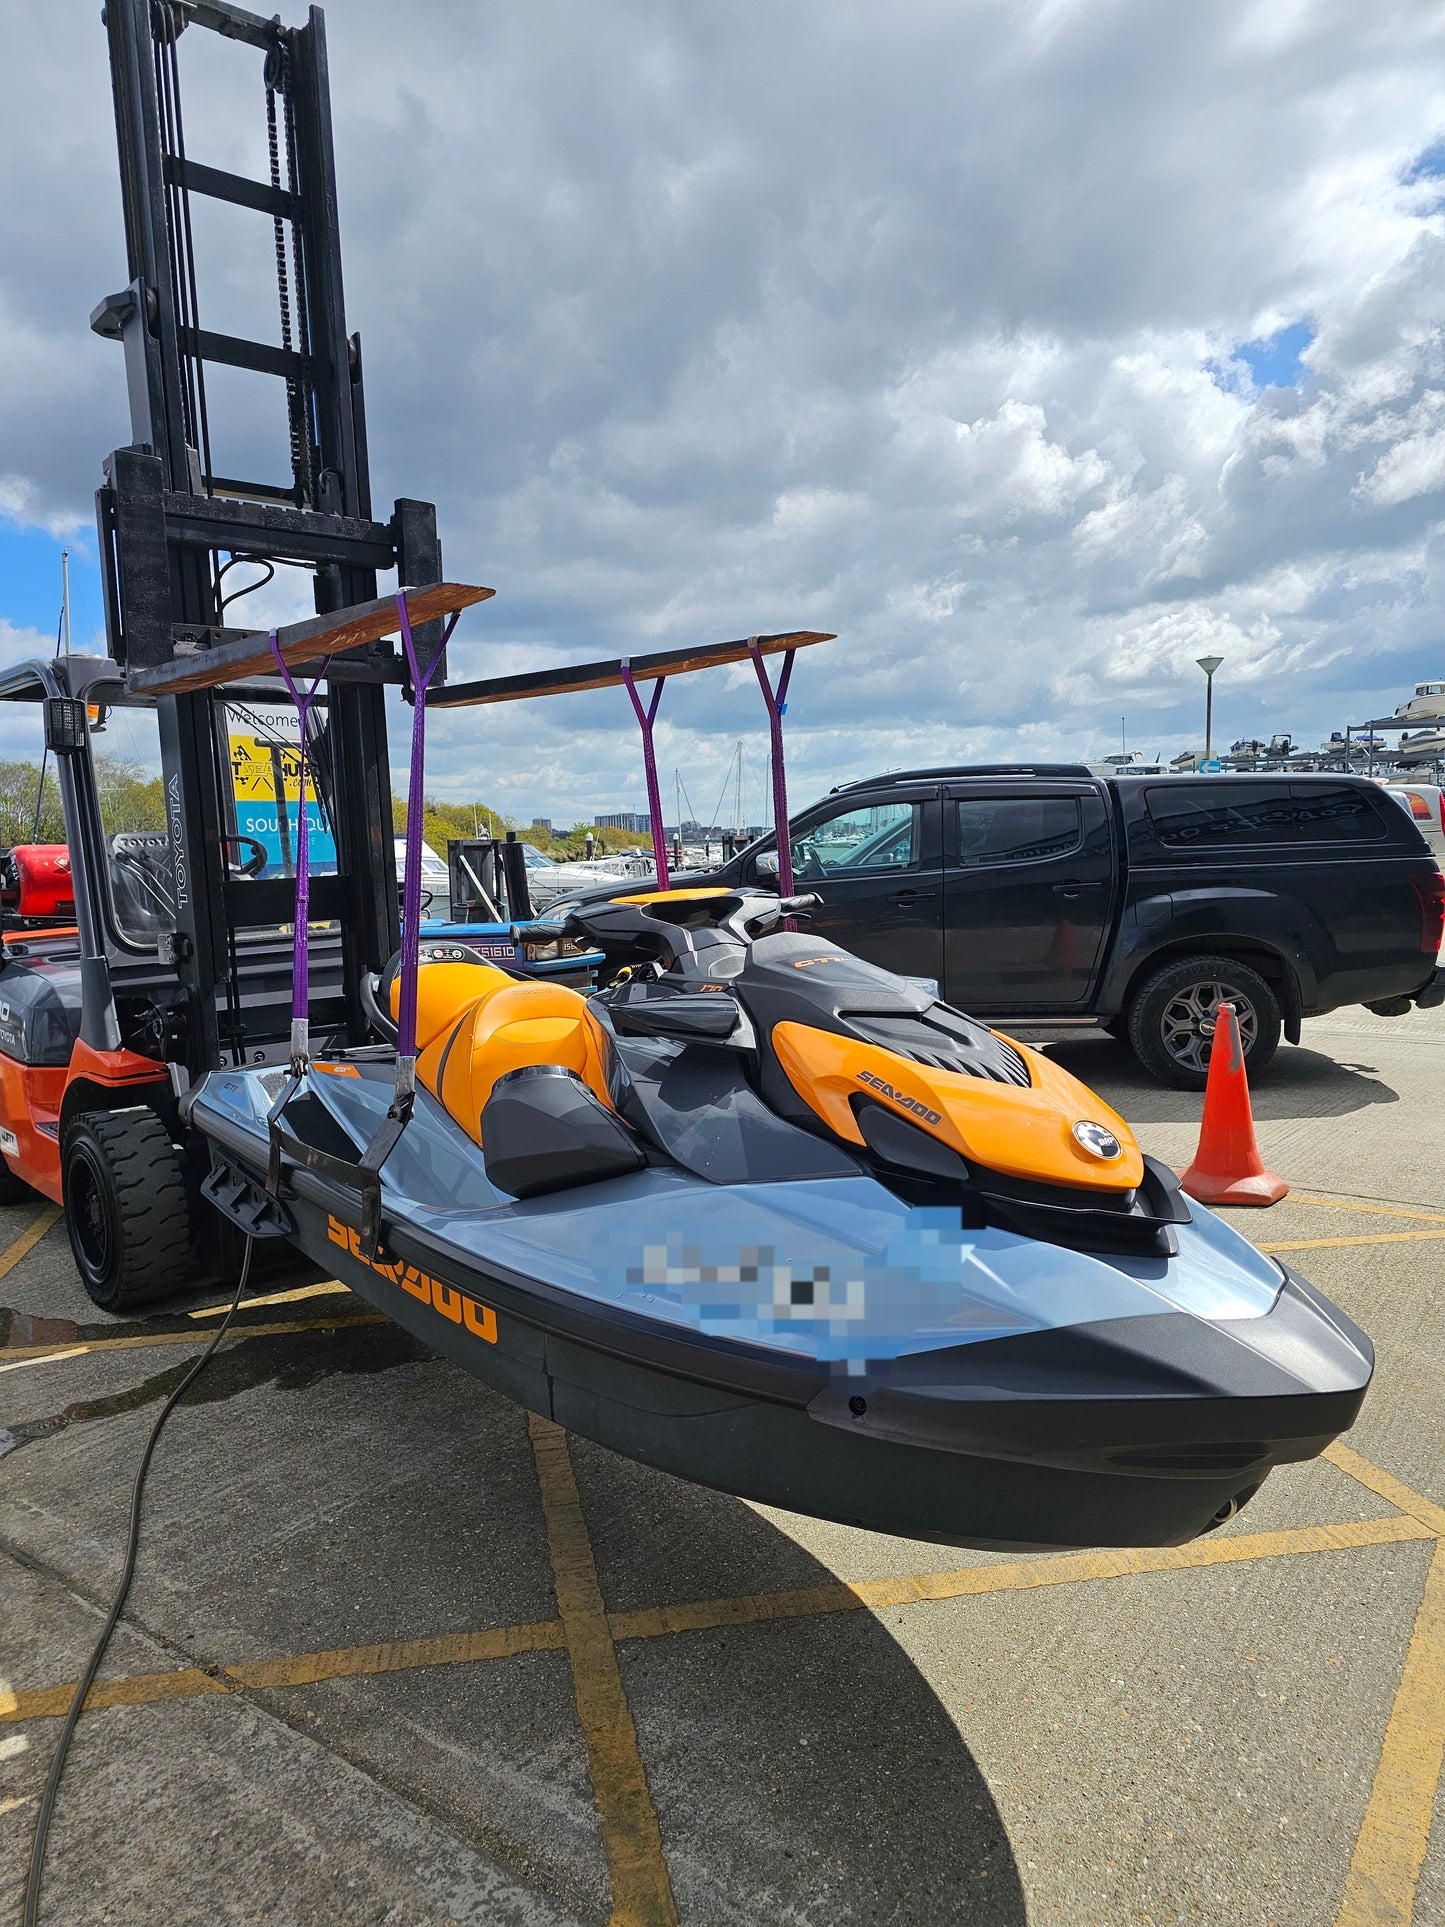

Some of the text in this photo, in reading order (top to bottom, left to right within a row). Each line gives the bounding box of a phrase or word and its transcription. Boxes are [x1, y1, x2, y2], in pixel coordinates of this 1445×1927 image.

[226, 708, 299, 728] Welcome
[246, 818, 298, 833] SOUH
[168, 773, 188, 909] TOYOTA
[700, 984, 723, 992] 170
[1097, 1135, 1115, 1147] BRP
